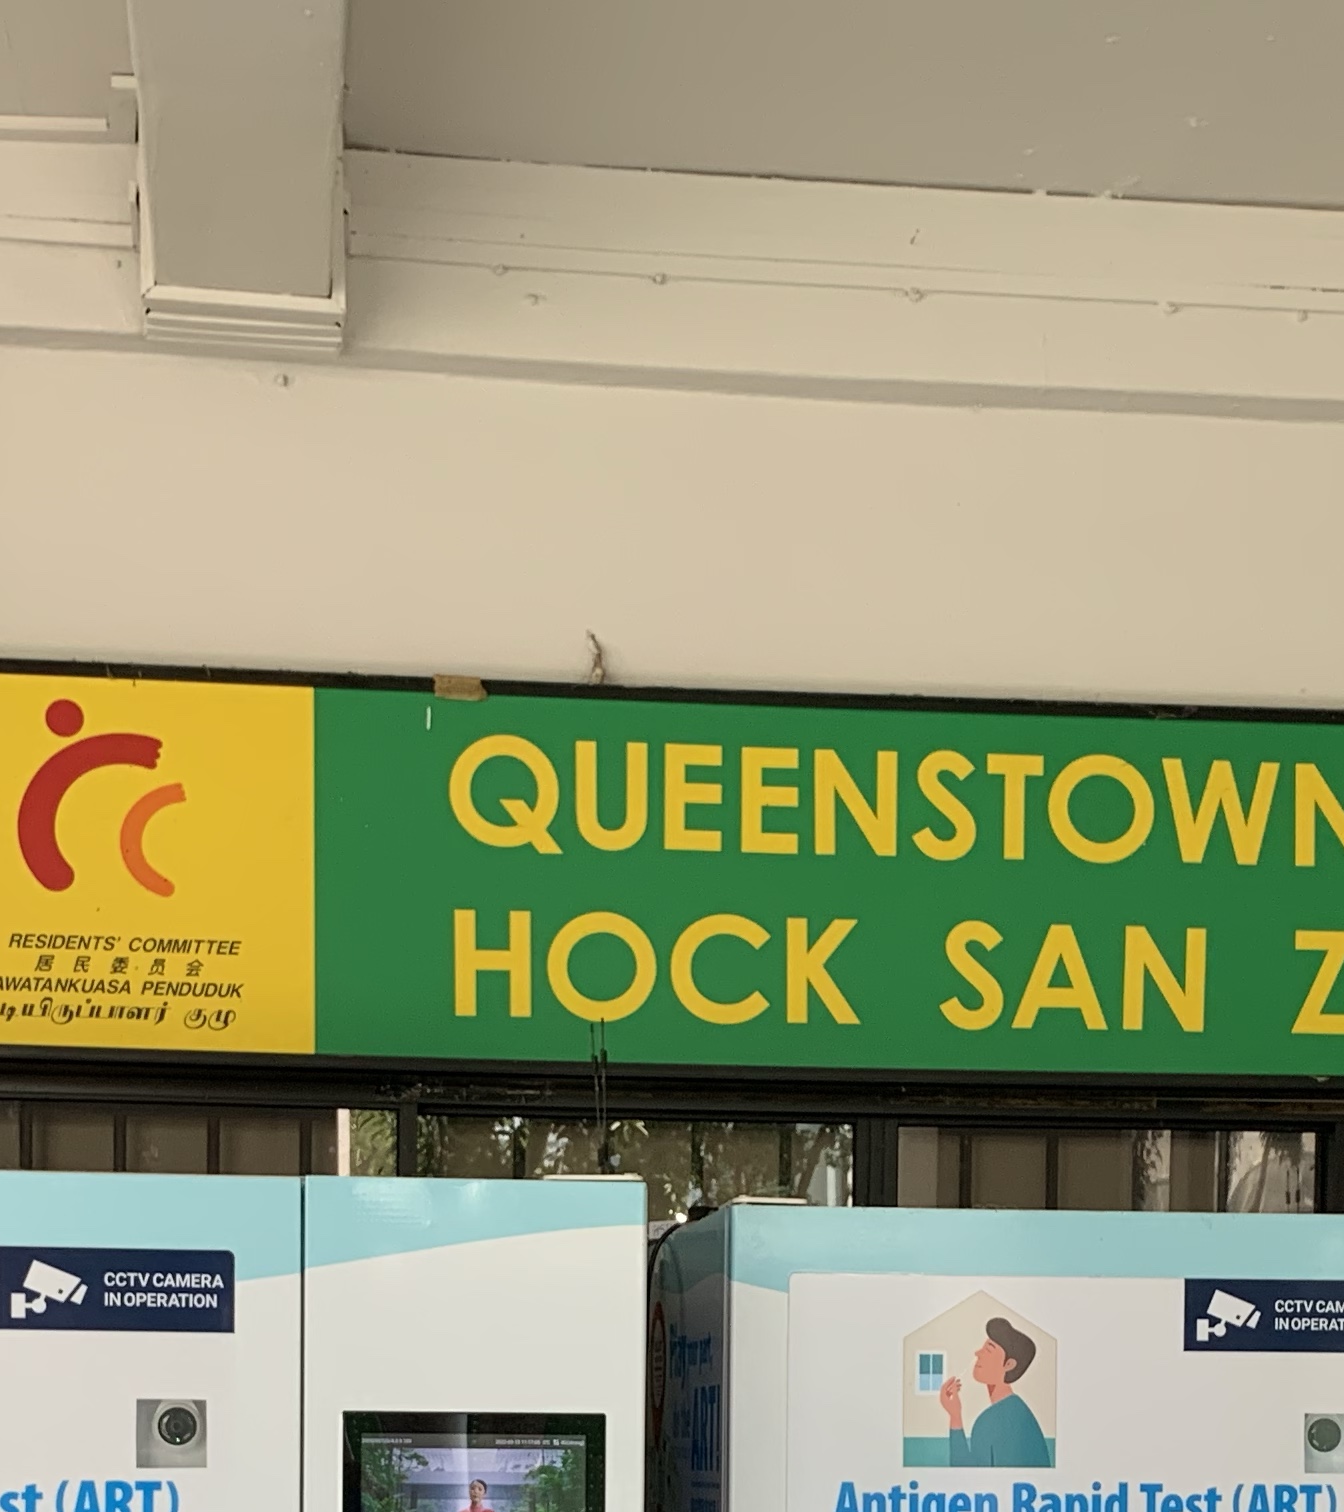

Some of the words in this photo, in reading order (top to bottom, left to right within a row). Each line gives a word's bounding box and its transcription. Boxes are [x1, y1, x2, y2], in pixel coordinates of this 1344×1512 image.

[9, 934, 120, 950] RESIDENTS'
[129, 938, 241, 955] COMMITTEE
[454, 909, 860, 1032] HOCK
[940, 920, 1206, 1032] SAN
[141, 981, 243, 998] PENDUDUK
[104, 1272, 150, 1287] CCTV
[153, 1273, 224, 1288] CAMERA
[105, 1292, 122, 1307] IN
[124, 1291, 218, 1308] OPERATION
[1275, 1300, 1313, 1312] CCTV
[1274, 1316, 1288, 1332] IN
